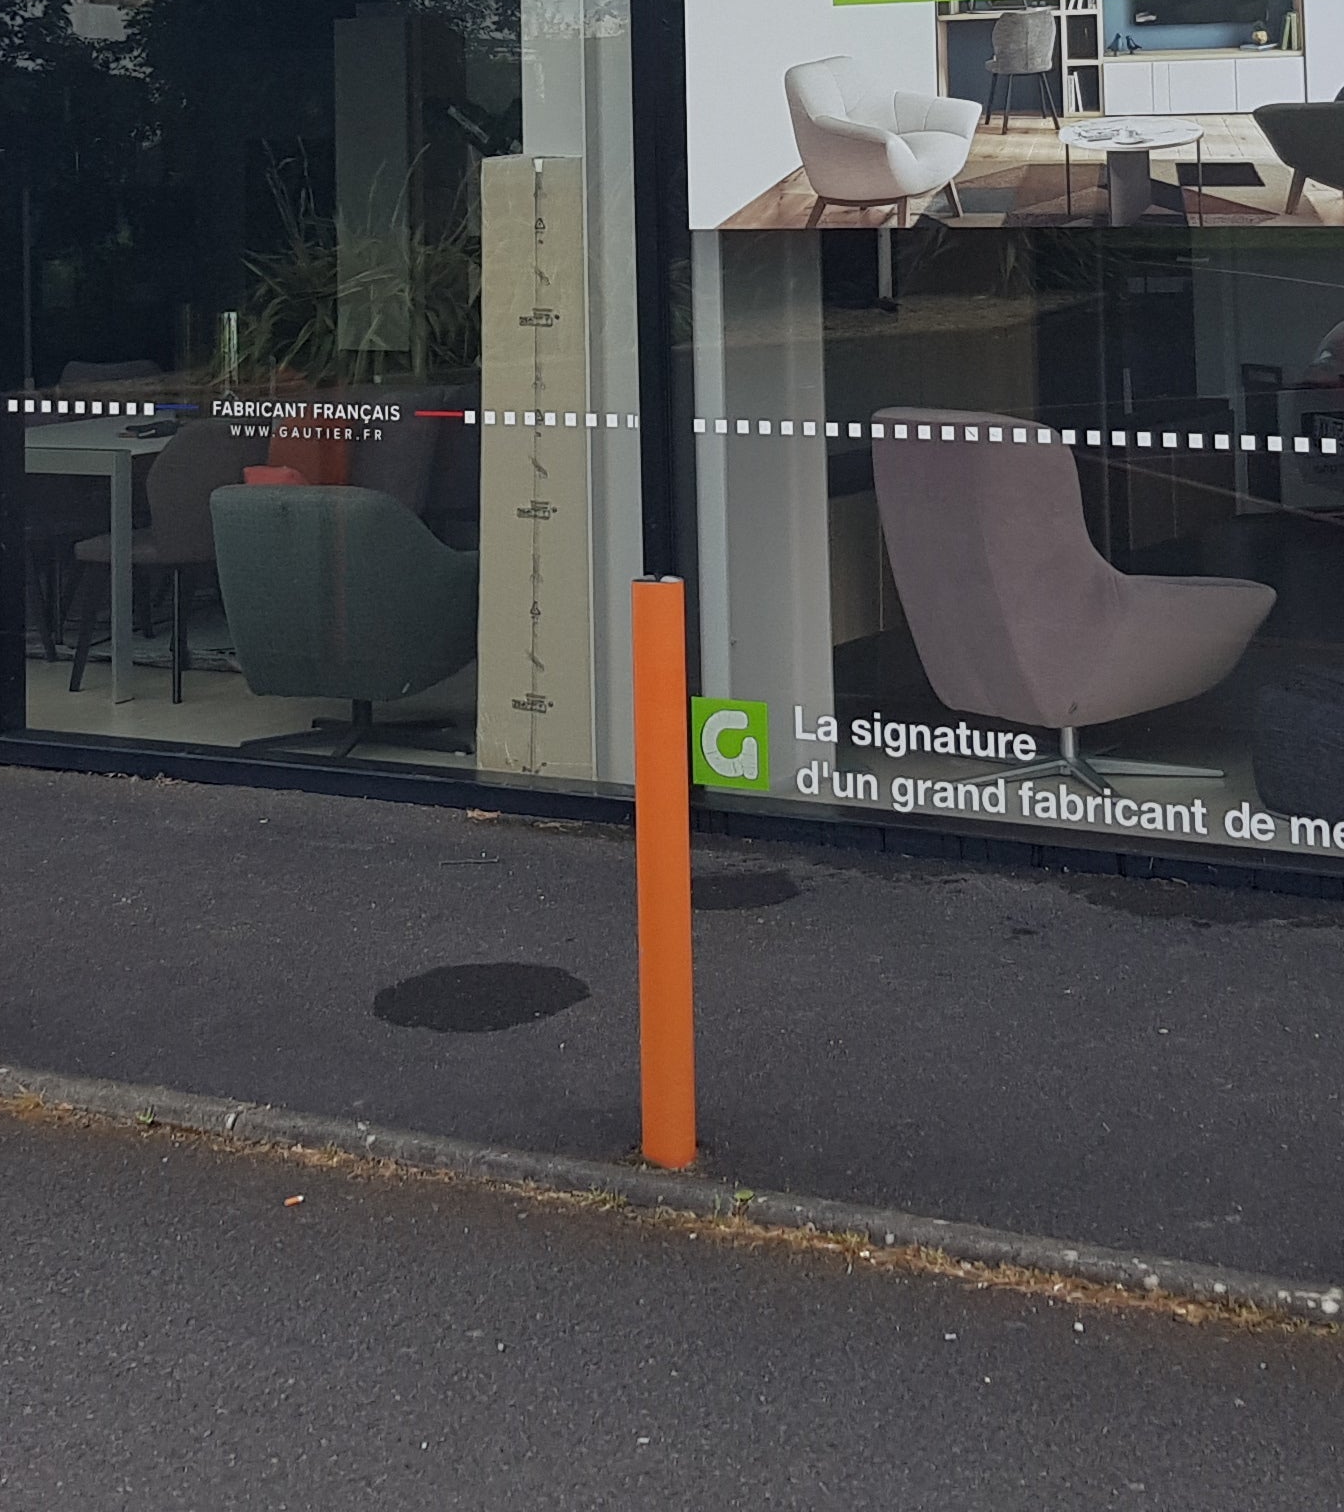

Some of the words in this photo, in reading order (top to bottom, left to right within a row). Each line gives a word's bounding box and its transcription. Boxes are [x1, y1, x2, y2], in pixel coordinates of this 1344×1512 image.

[212, 400, 307, 419] FABRICANT
[312, 403, 401, 424] FRANÇAIS
[229, 424, 383, 441] WWW.GAUTIER.FR
[792, 704, 839, 744] La
[851, 710, 1038, 762] signature
[795, 762, 880, 803] d'un
[891, 764, 1007, 816] grand
[1018, 780, 1209, 837] fabricant
[1223, 808, 1277, 843] de
